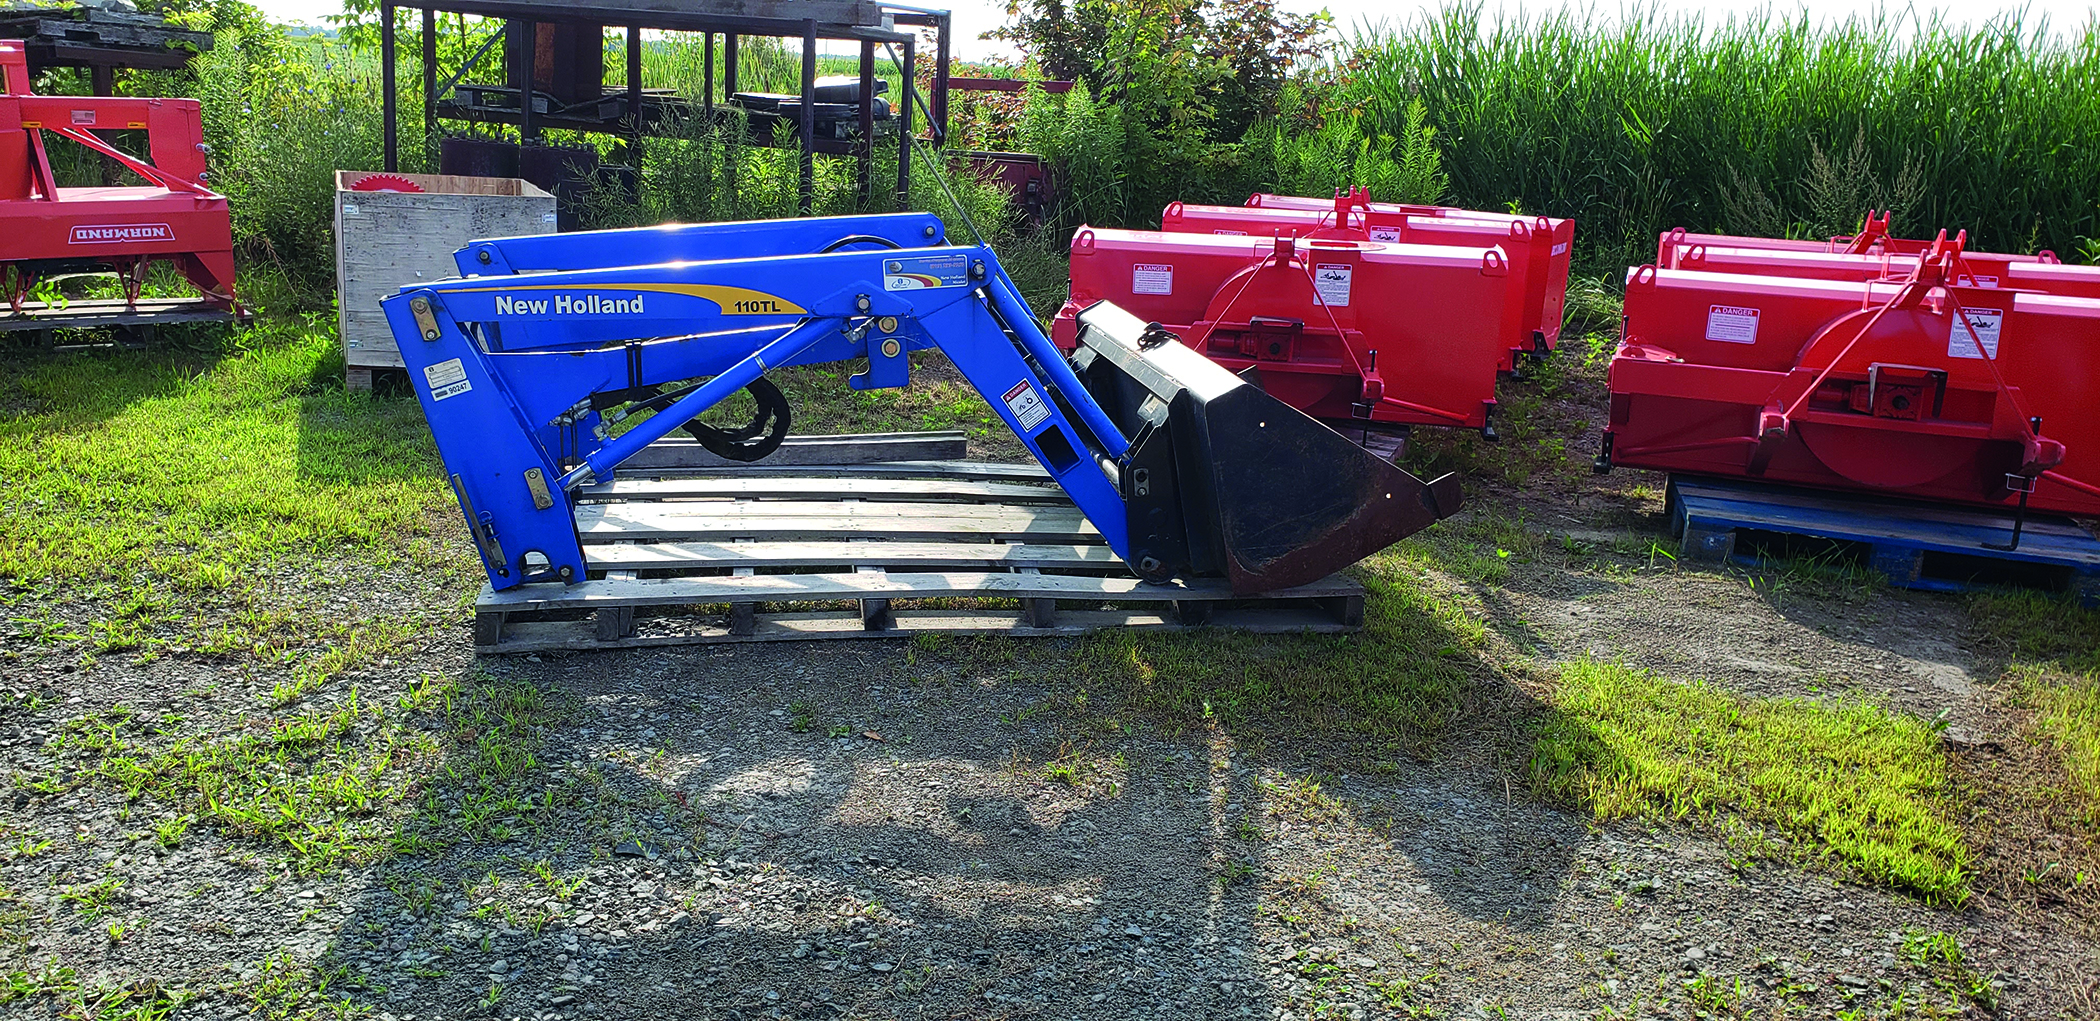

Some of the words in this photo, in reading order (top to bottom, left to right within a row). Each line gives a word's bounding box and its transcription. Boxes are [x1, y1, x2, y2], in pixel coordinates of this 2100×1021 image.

[76, 227, 165, 239] NORMAND
[495, 295, 548, 315] New
[554, 295, 644, 315] Holland
[734, 300, 781, 313] 110TL
[1722, 308, 1753, 316] DANGER
[448, 383, 467, 394] 90247
